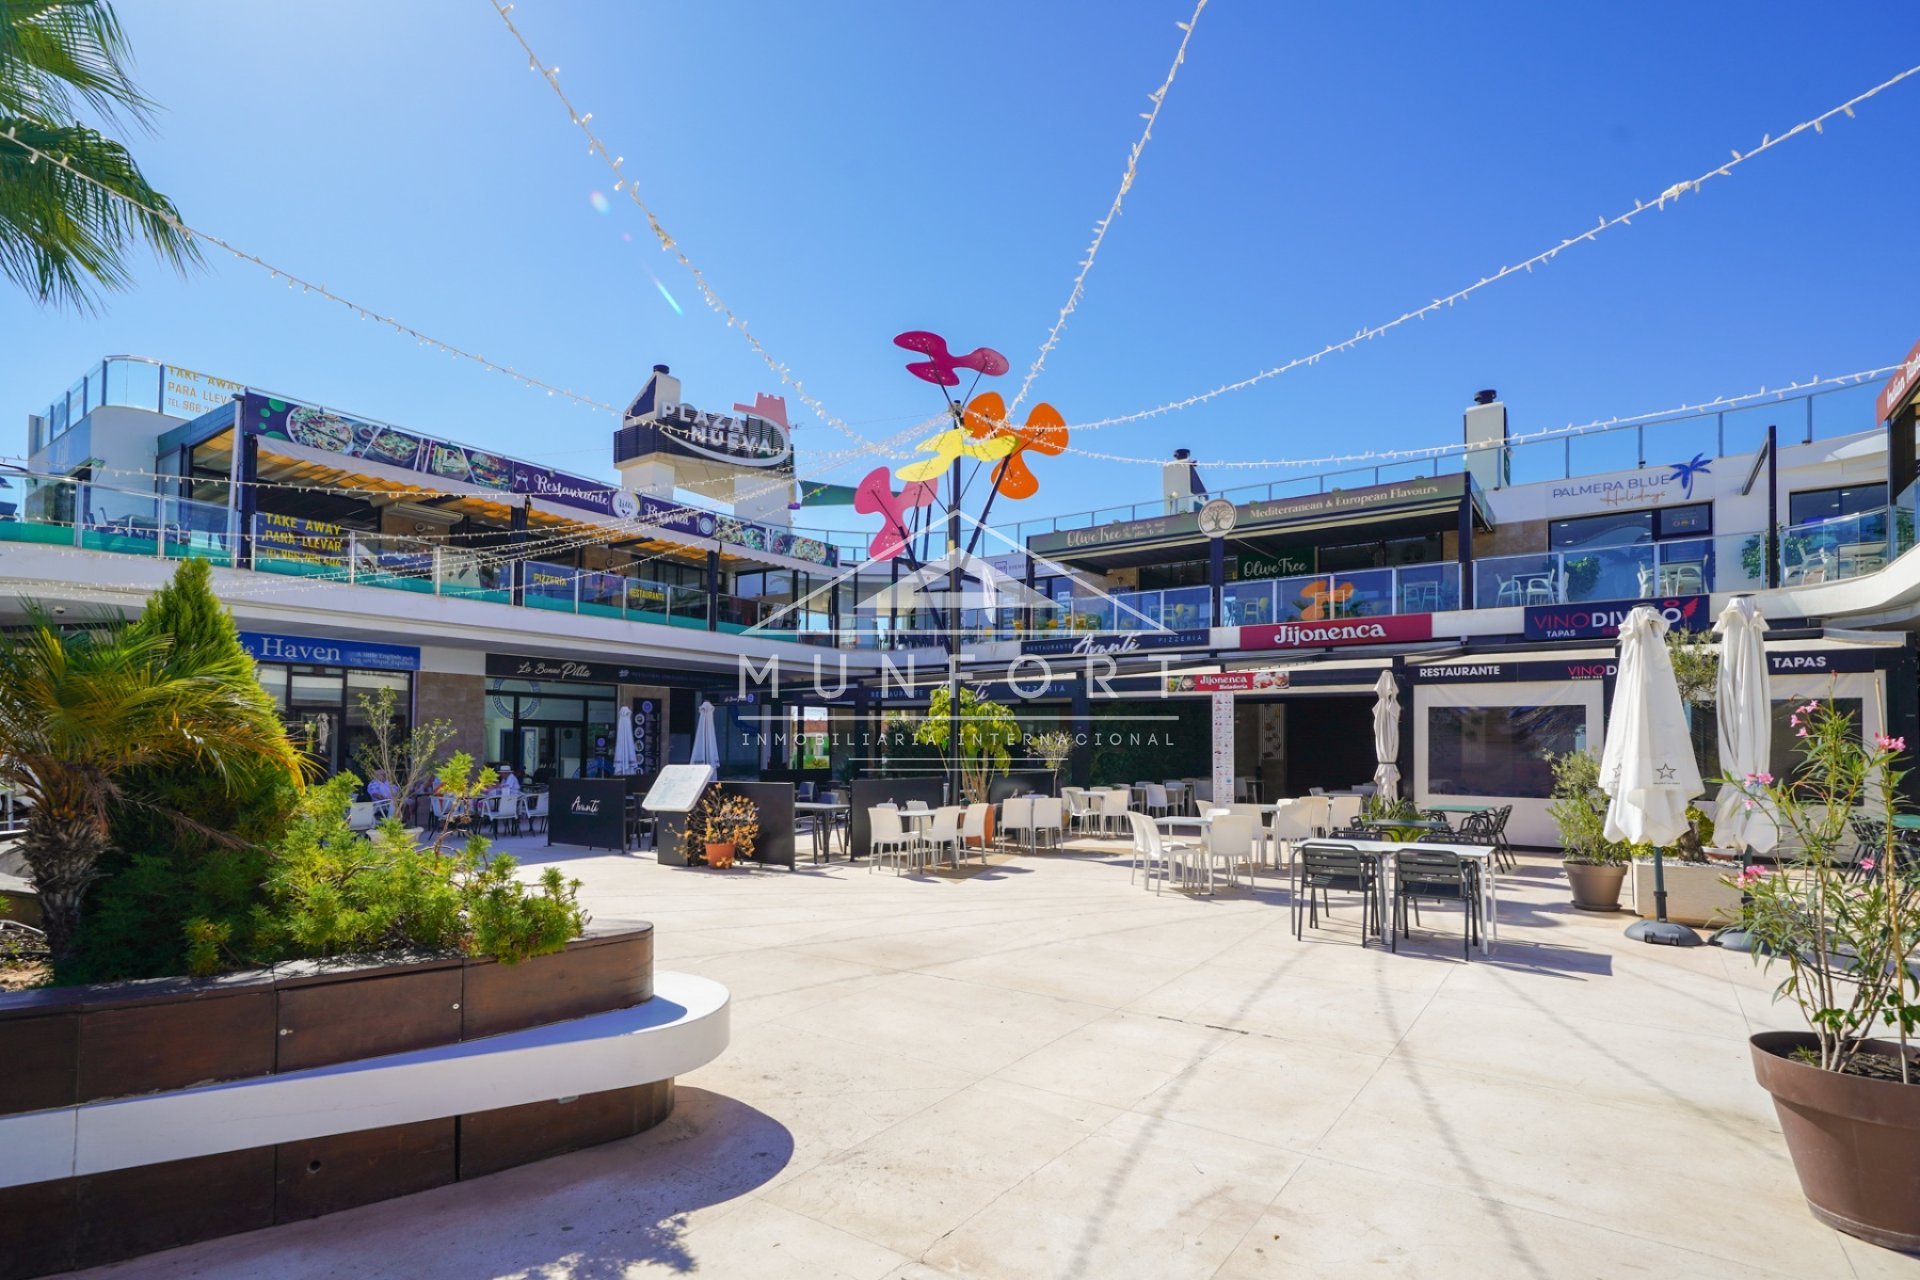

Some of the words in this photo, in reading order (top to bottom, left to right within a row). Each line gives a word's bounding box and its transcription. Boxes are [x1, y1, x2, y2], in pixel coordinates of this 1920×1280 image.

[167, 365, 199, 382] TAKE
[207, 376, 244, 392] AWAY
[167, 381, 197, 397] PARA
[660, 402, 745, 433] PLAZA
[689, 425, 774, 456] NUEVA
[533, 473, 609, 506] Restaurante
[1552, 480, 1624, 499] PALMERA
[1628, 474, 1670, 490] BLUE
[1600, 487, 1666, 506] Holidays
[1249, 499, 1323, 519] Mediterranean
[1325, 499, 1333, 508] &
[1335, 491, 1388, 507] European
[1390, 485, 1439, 500] Flavours
[265, 512, 298, 529] TAKE
[305, 520, 342, 535] AWAY
[265, 530, 296, 545] PARA
[302, 536, 342, 552] LLEVAR
[1244, 561, 1279, 577] Olive
[1278, 557, 1307, 573] Tree
[1072, 632, 1142, 656] Avanti
[1274, 623, 1387, 646] Jijonenca
[1546, 630, 1576, 638] TAPAS
[260, 637, 340, 661] Haven
[1419, 665, 1501, 678] RESTAURANTE
[1772, 656, 1827, 669] TAPAS
[1200, 675, 1248, 687] Jijonenca
